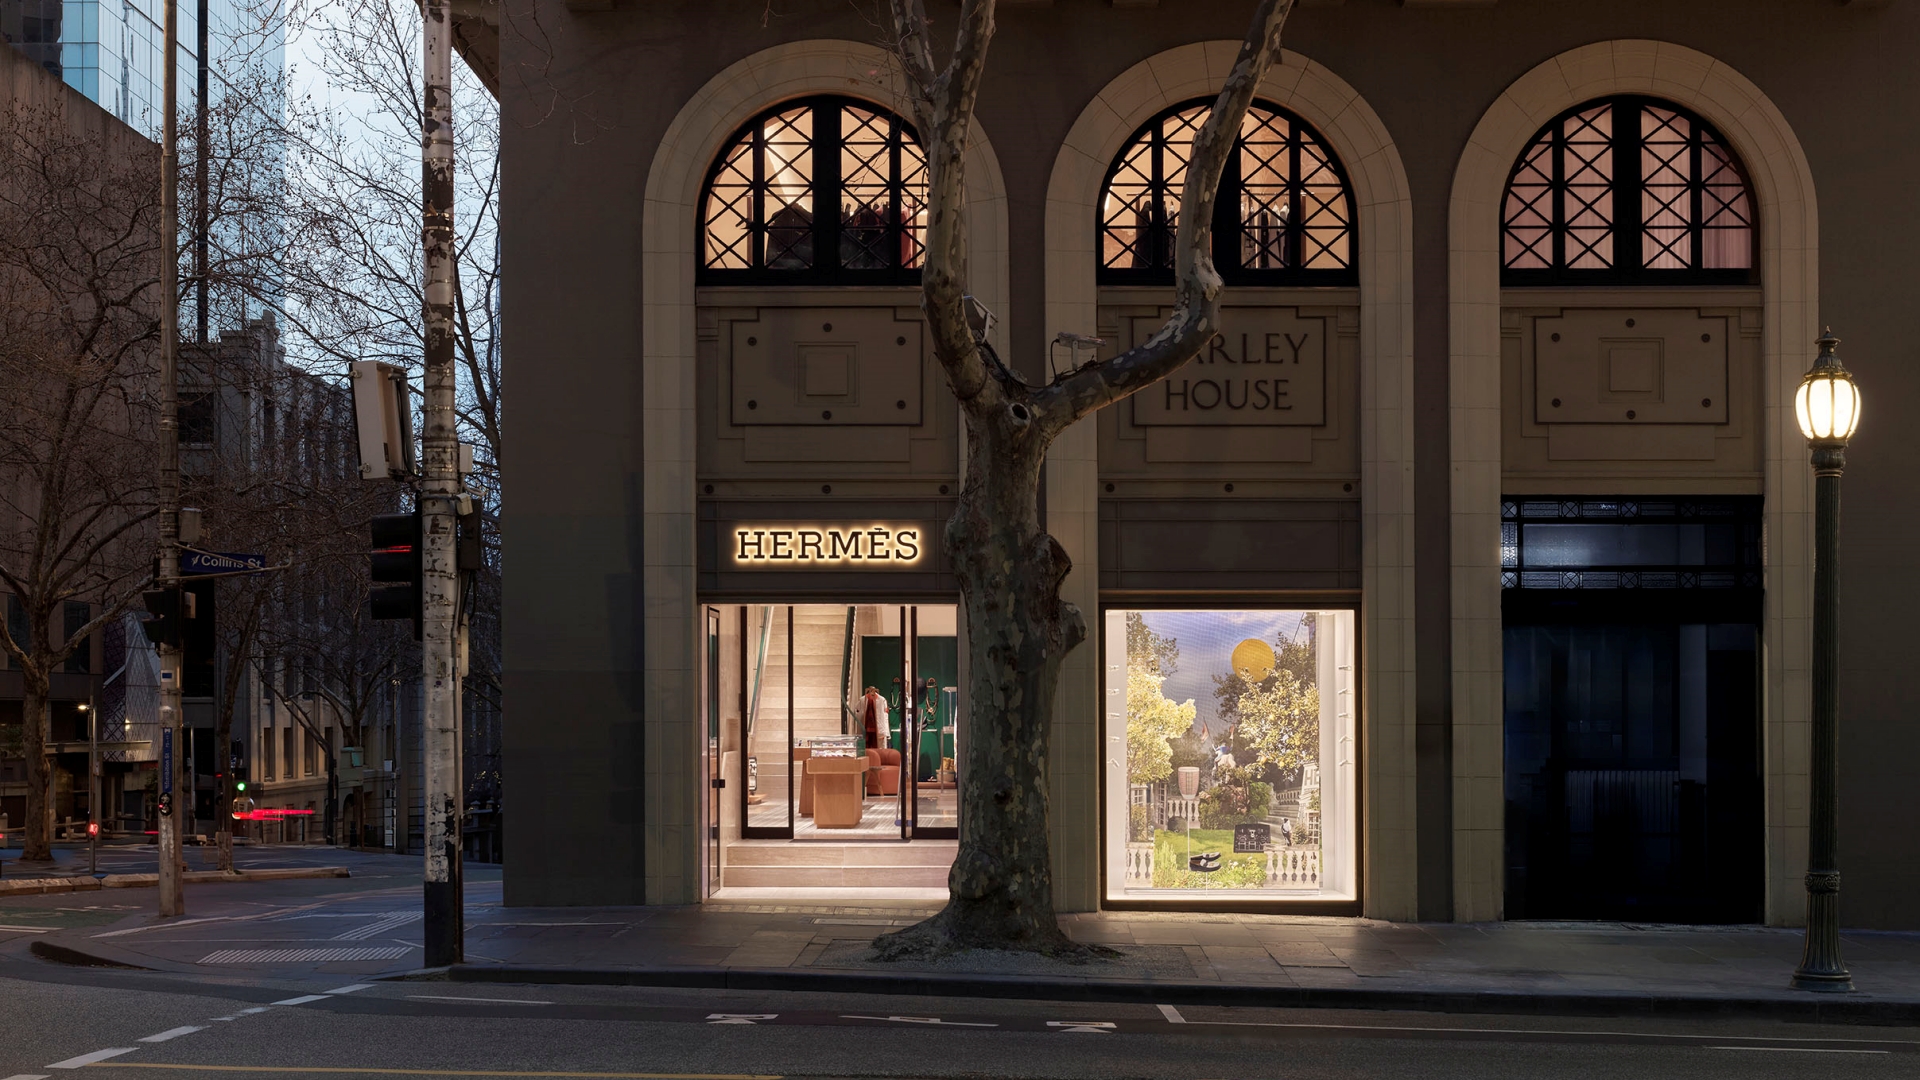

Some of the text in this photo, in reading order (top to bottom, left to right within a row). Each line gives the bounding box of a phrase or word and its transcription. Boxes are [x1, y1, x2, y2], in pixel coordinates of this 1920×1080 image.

[1147, 333, 1308, 364] RLEY
[1165, 379, 1292, 410] HOUSE
[737, 527, 918, 560] HERMÈS
[201, 555, 262, 569] Collins St
